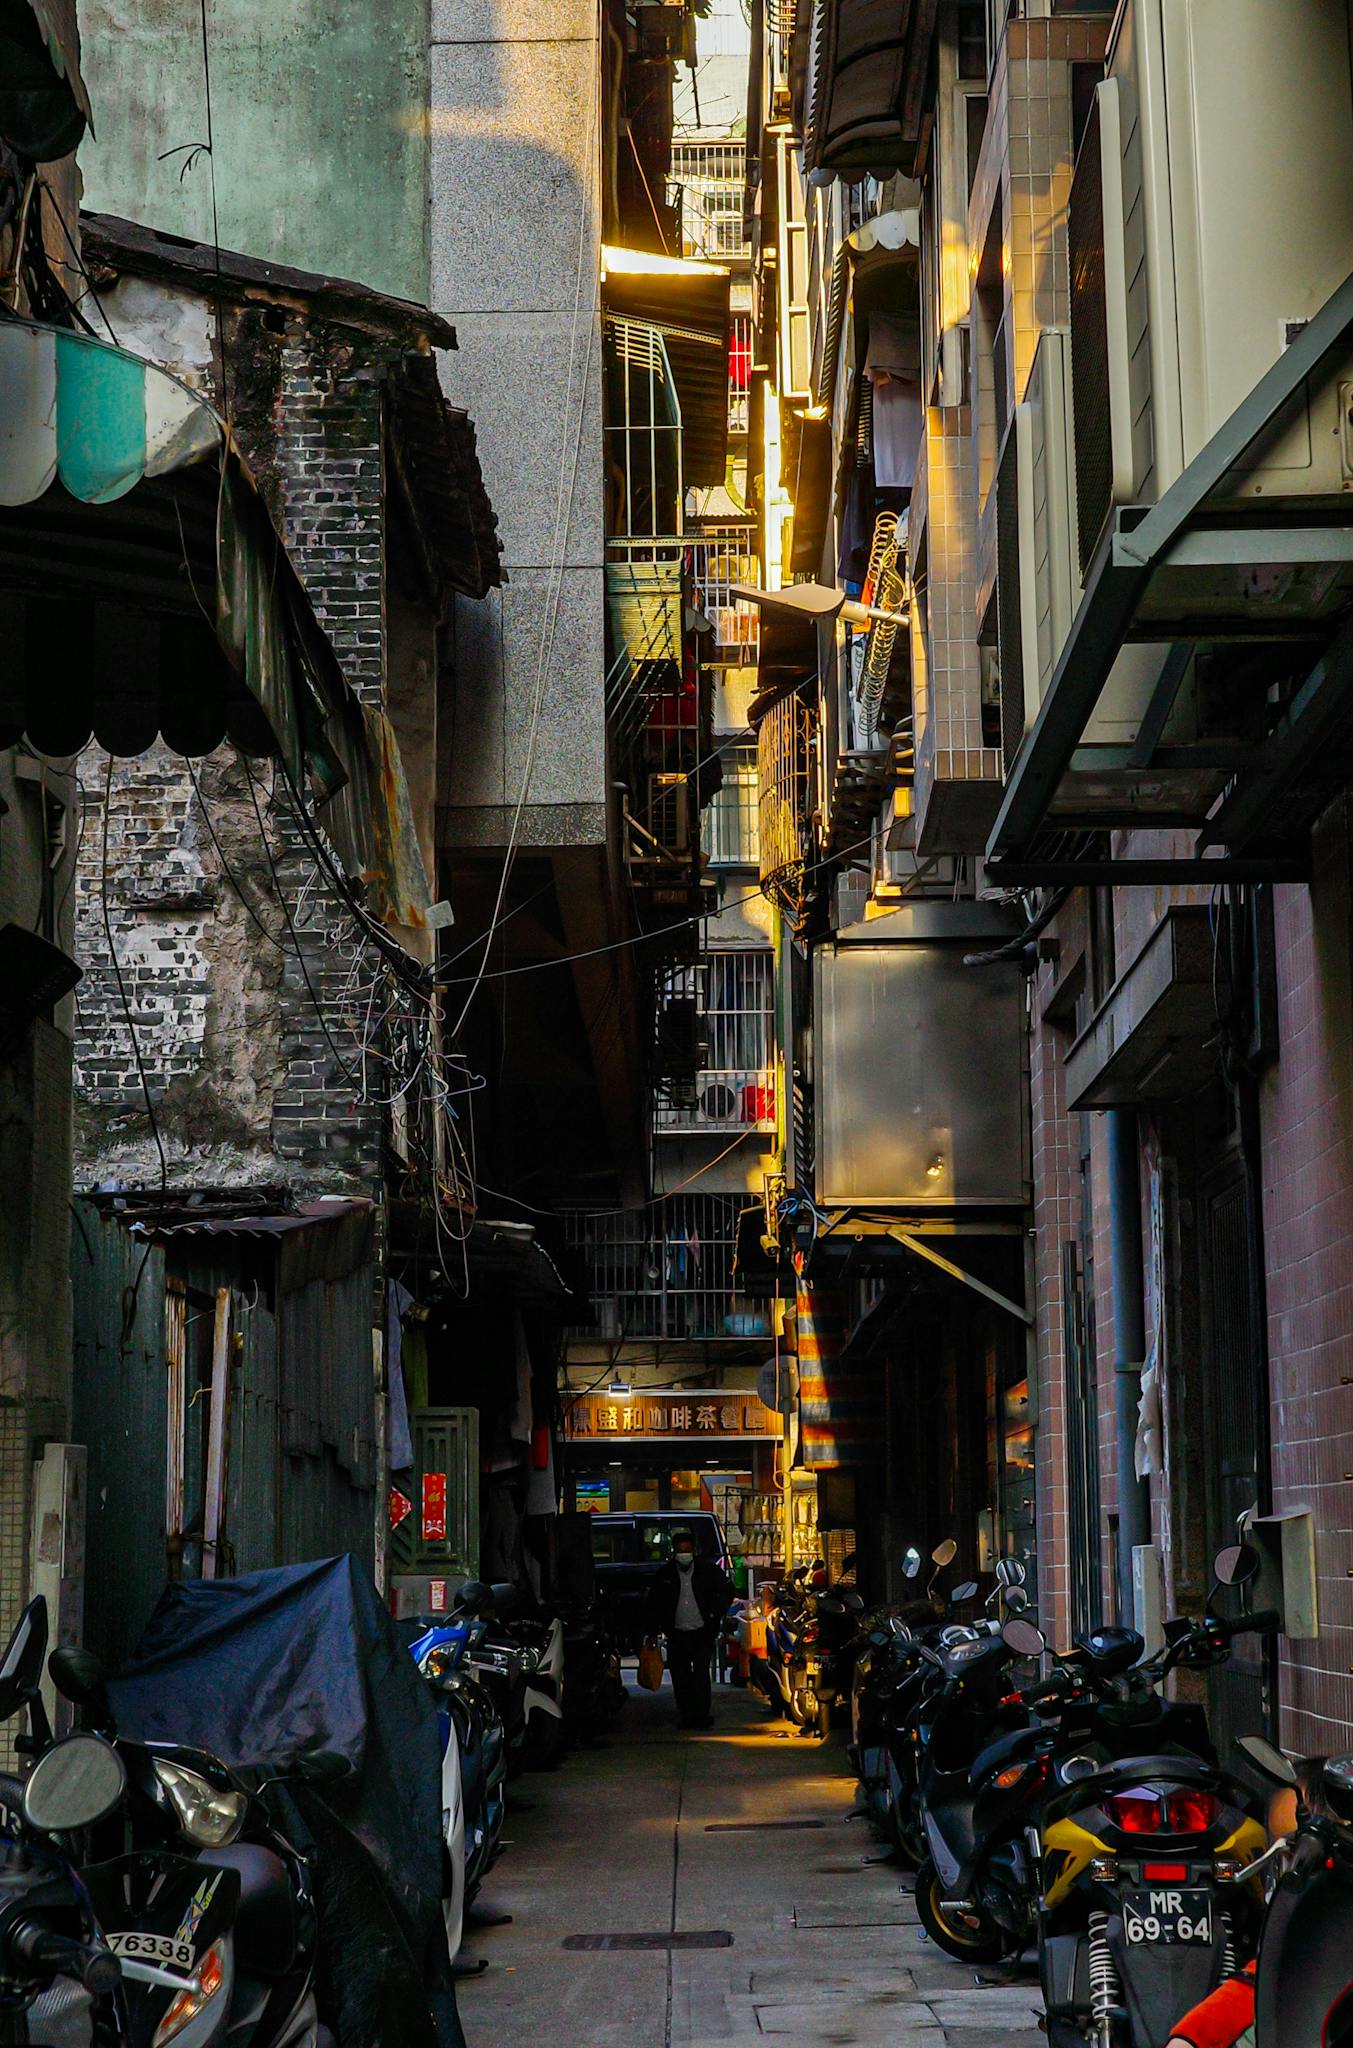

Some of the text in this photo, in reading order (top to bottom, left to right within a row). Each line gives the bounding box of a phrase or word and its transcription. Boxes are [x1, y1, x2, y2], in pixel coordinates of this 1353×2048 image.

[1150, 1892, 1184, 1914] MR
[1128, 1917, 1210, 1943] 69-64
[111, 1935, 191, 1963] 76338
